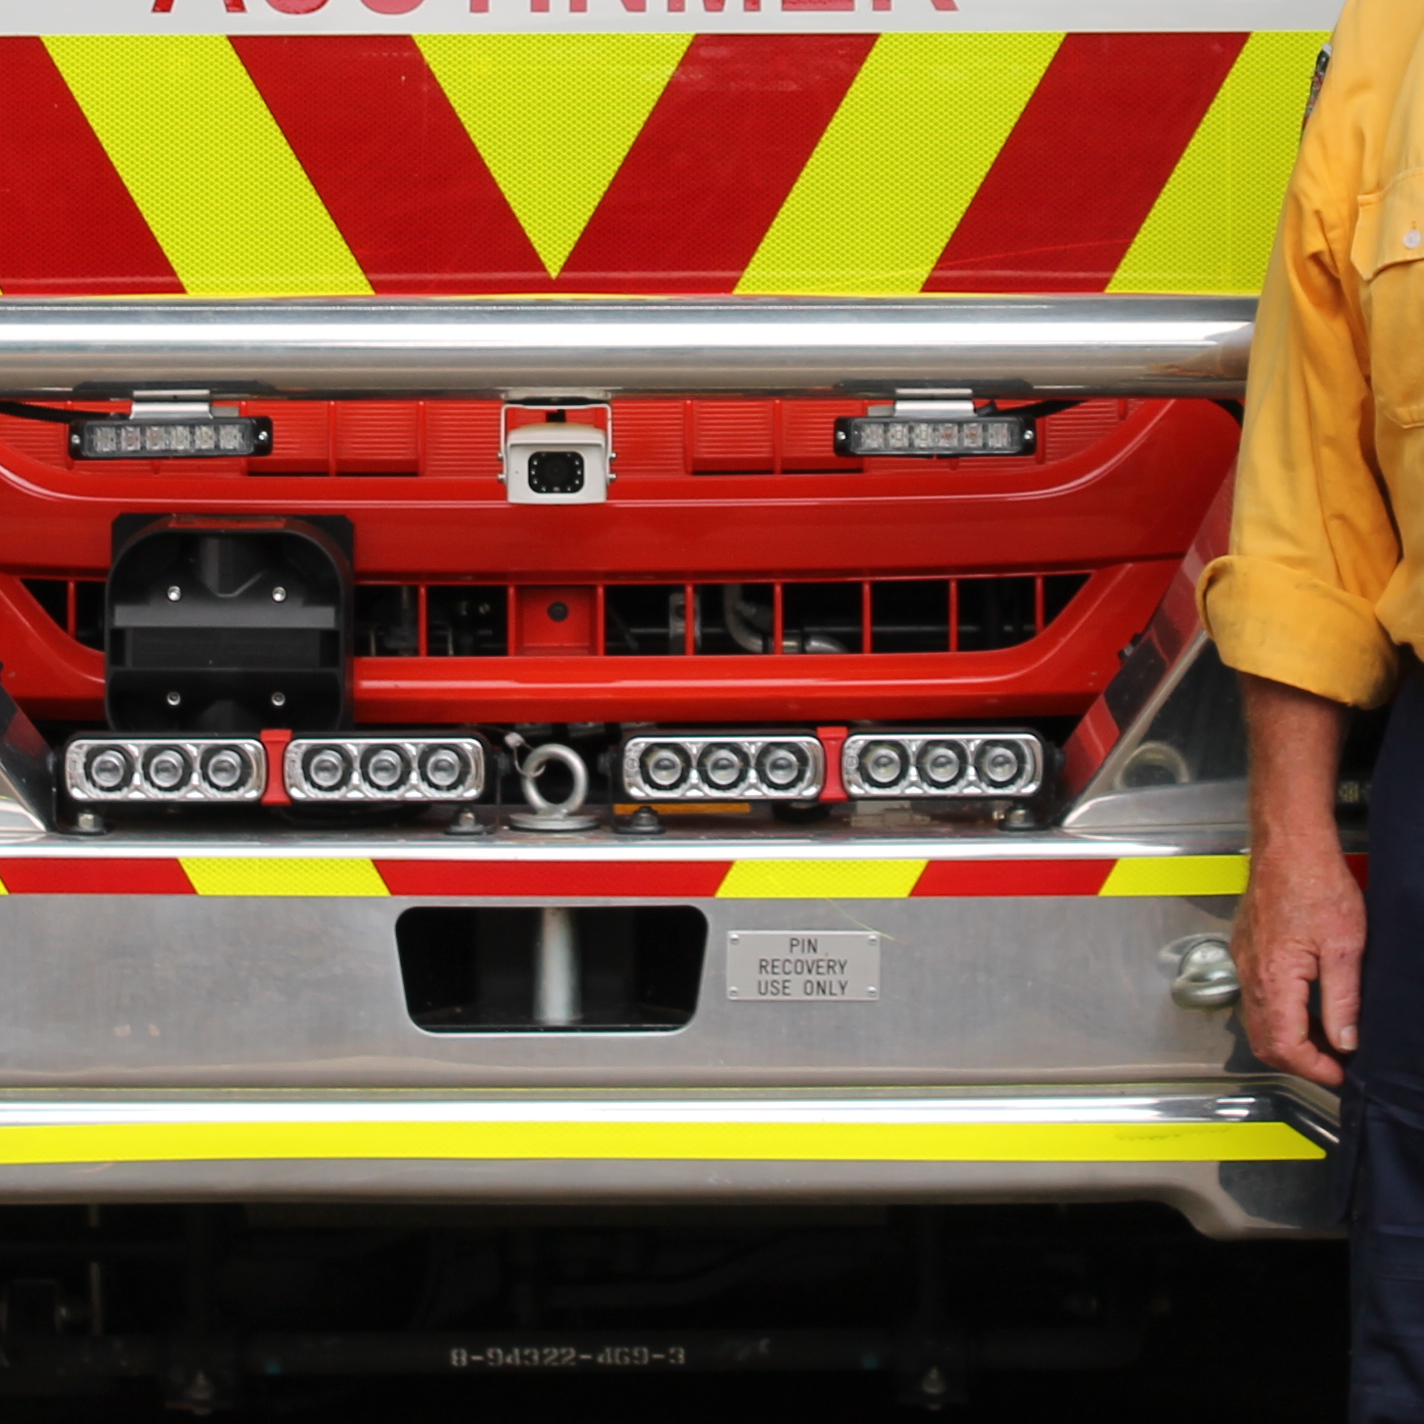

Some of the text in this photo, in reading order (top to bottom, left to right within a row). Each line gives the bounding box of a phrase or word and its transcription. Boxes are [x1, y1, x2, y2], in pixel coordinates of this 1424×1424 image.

[789, 938, 818, 954] PIN
[759, 958, 848, 975] RECOVERY
[758, 979, 848, 996] USE ONLY
